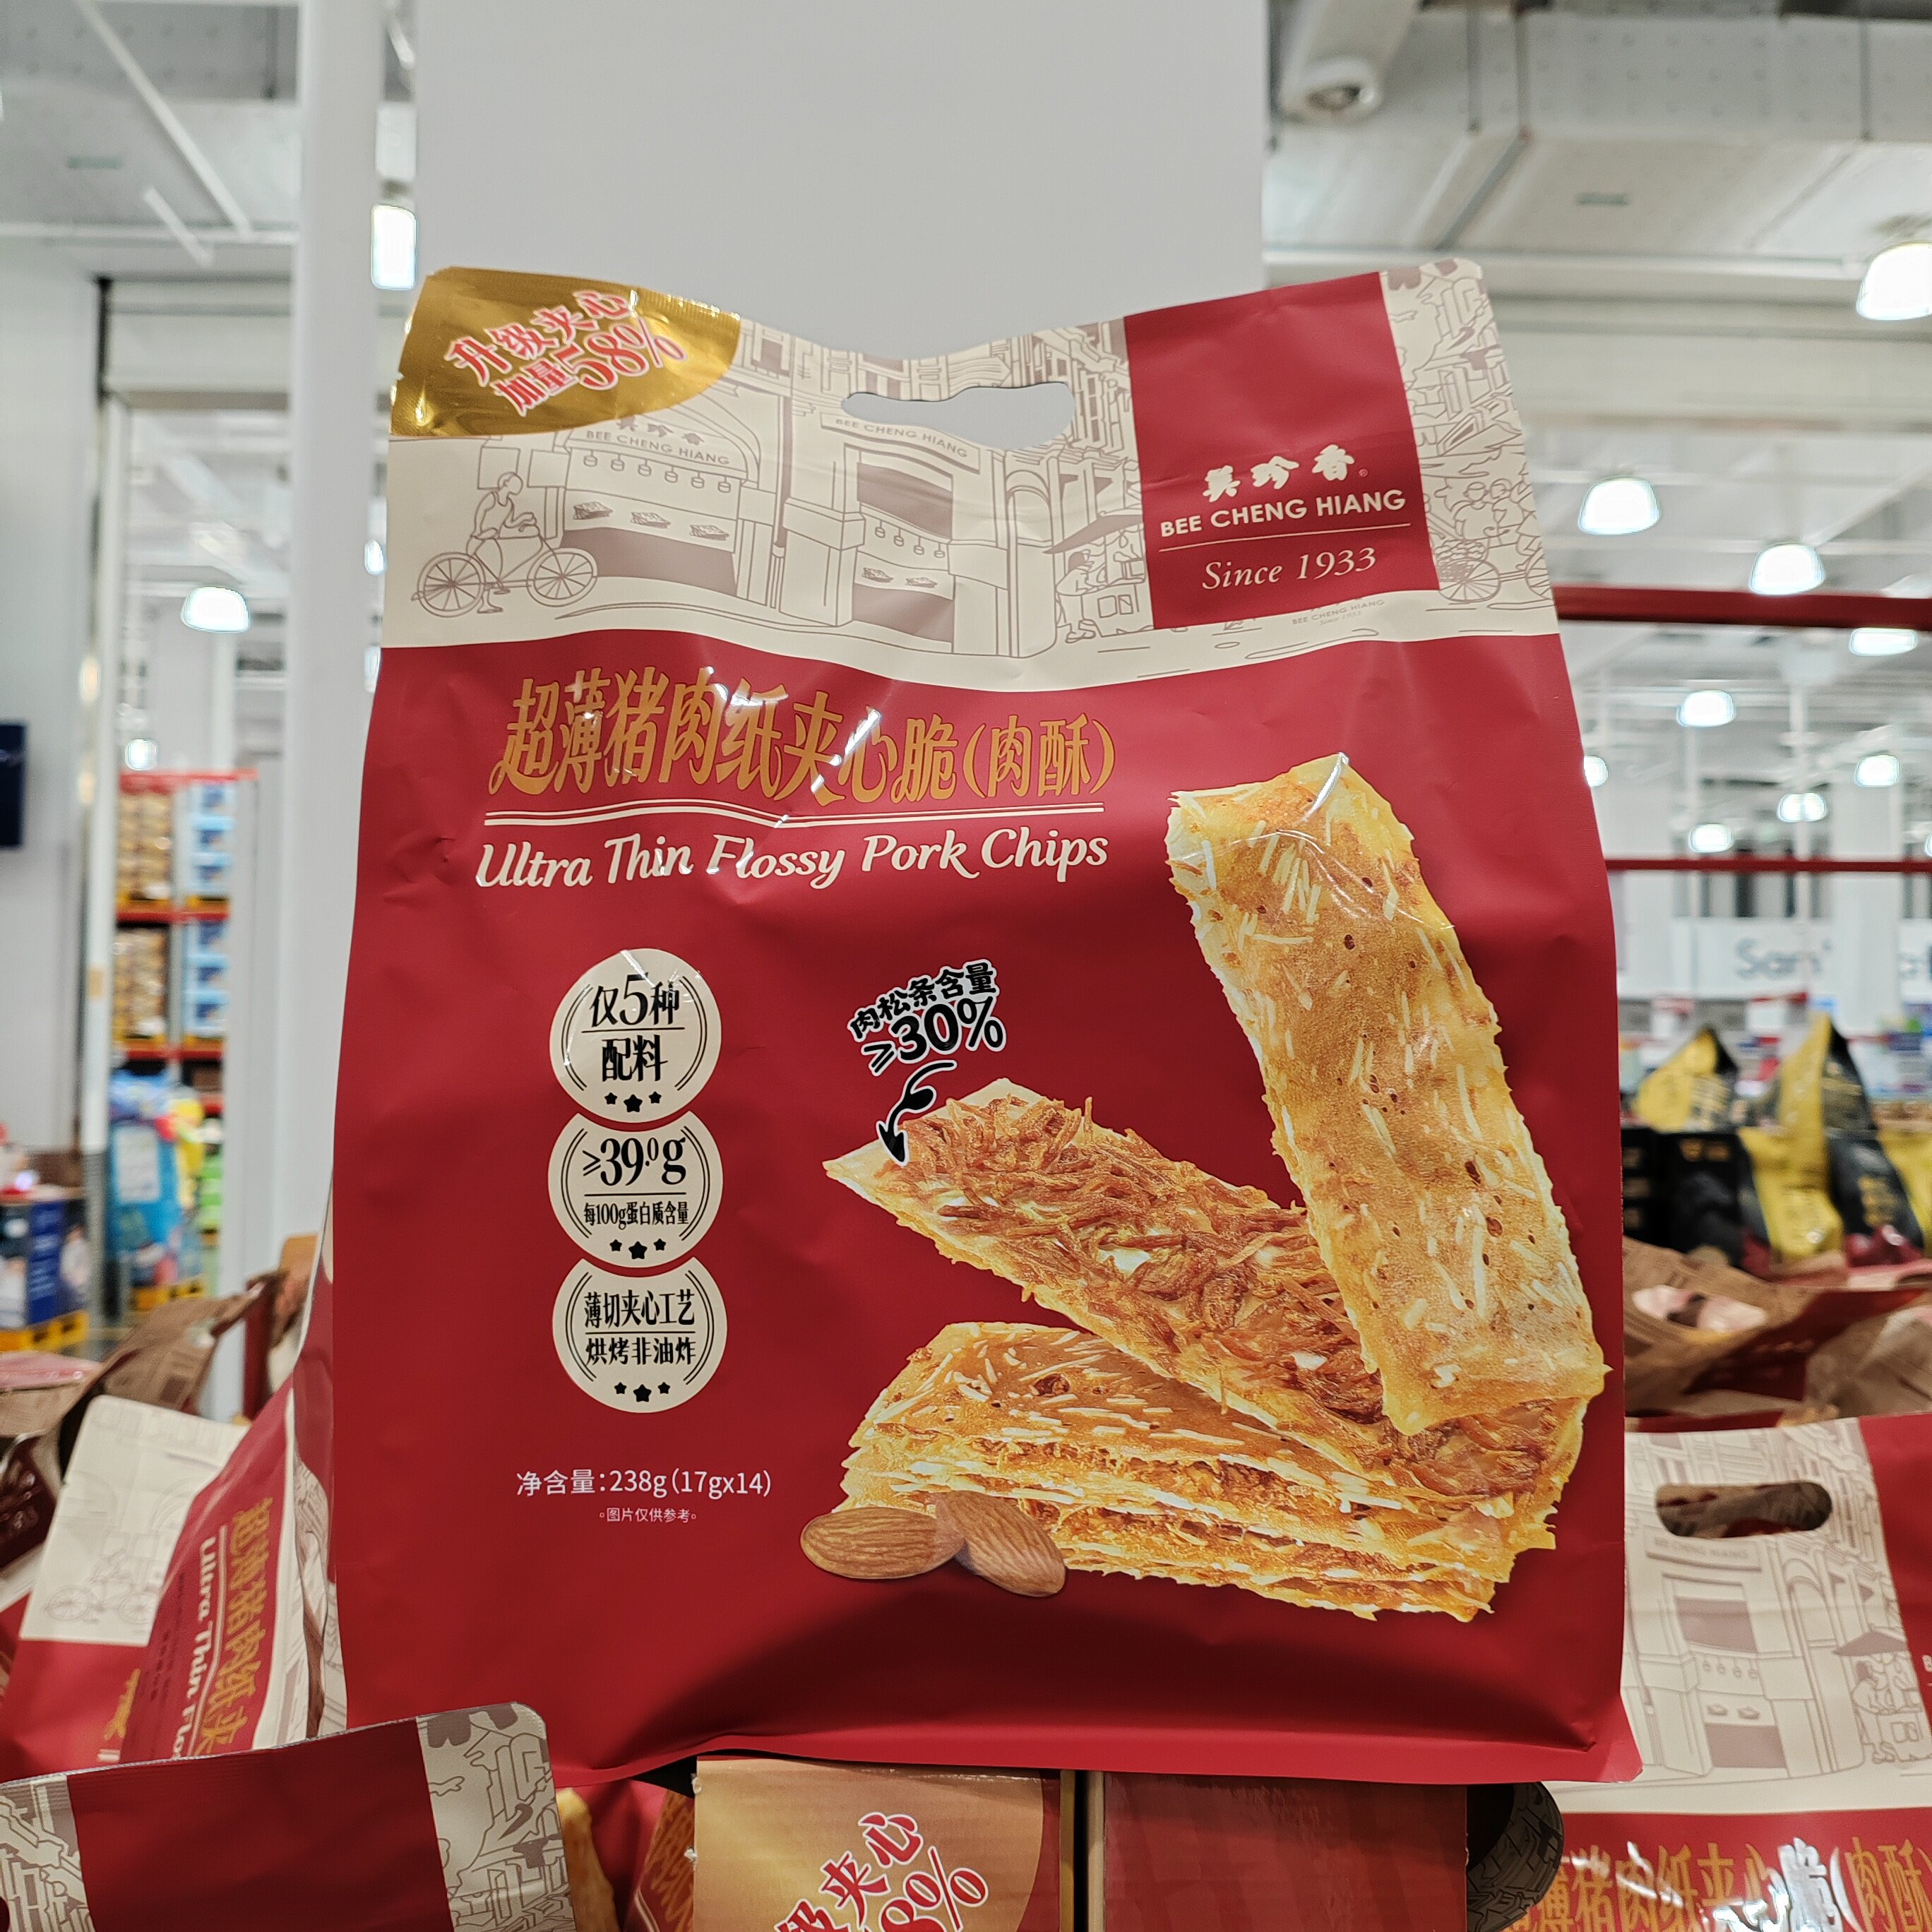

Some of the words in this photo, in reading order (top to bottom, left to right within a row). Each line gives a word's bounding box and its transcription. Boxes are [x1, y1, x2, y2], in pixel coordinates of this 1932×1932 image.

[444, 290, 633, 388] 升级夹心
[489, 317, 688, 417] 加量58%
[586, 429, 612, 442] BEE
[616, 435, 673, 454] CHENG
[678, 447, 730, 465] HIANG
[835, 418, 862, 429] BEE
[863, 424, 918, 439] CHENG
[922, 433, 968, 458] HIANG
[1160, 514, 1203, 537] BEE
[1210, 499, 1308, 527] CHENG
[1316, 489, 1407, 517] HIANG
[1202, 561, 1283, 590] Since
[1296, 547, 1376, 580] 1933
[1292, 616, 1309, 625] BEE
[1311, 607, 1348, 621] CHENG
[1350, 599, 1385, 611] HIANG
[475, 841, 593, 888] Ultra
[604, 833, 695, 884] Thin
[706, 833, 846, 890] Flossy
[861, 829, 980, 879] Pork
[981, 825, 1109, 883] Chips
[589, 972, 679, 1027] 仅5种
[849, 961, 997, 1039] 肉松条含量
[601, 1034, 669, 1082] 配料
[864, 996, 1004, 1074] ≥30%
[583, 1201, 690, 1230] 每100g蛋白质含量
[583, 1289, 696, 1330] 薄切夹心工艺
[585, 1337, 697, 1366] 烘烤非油炸
